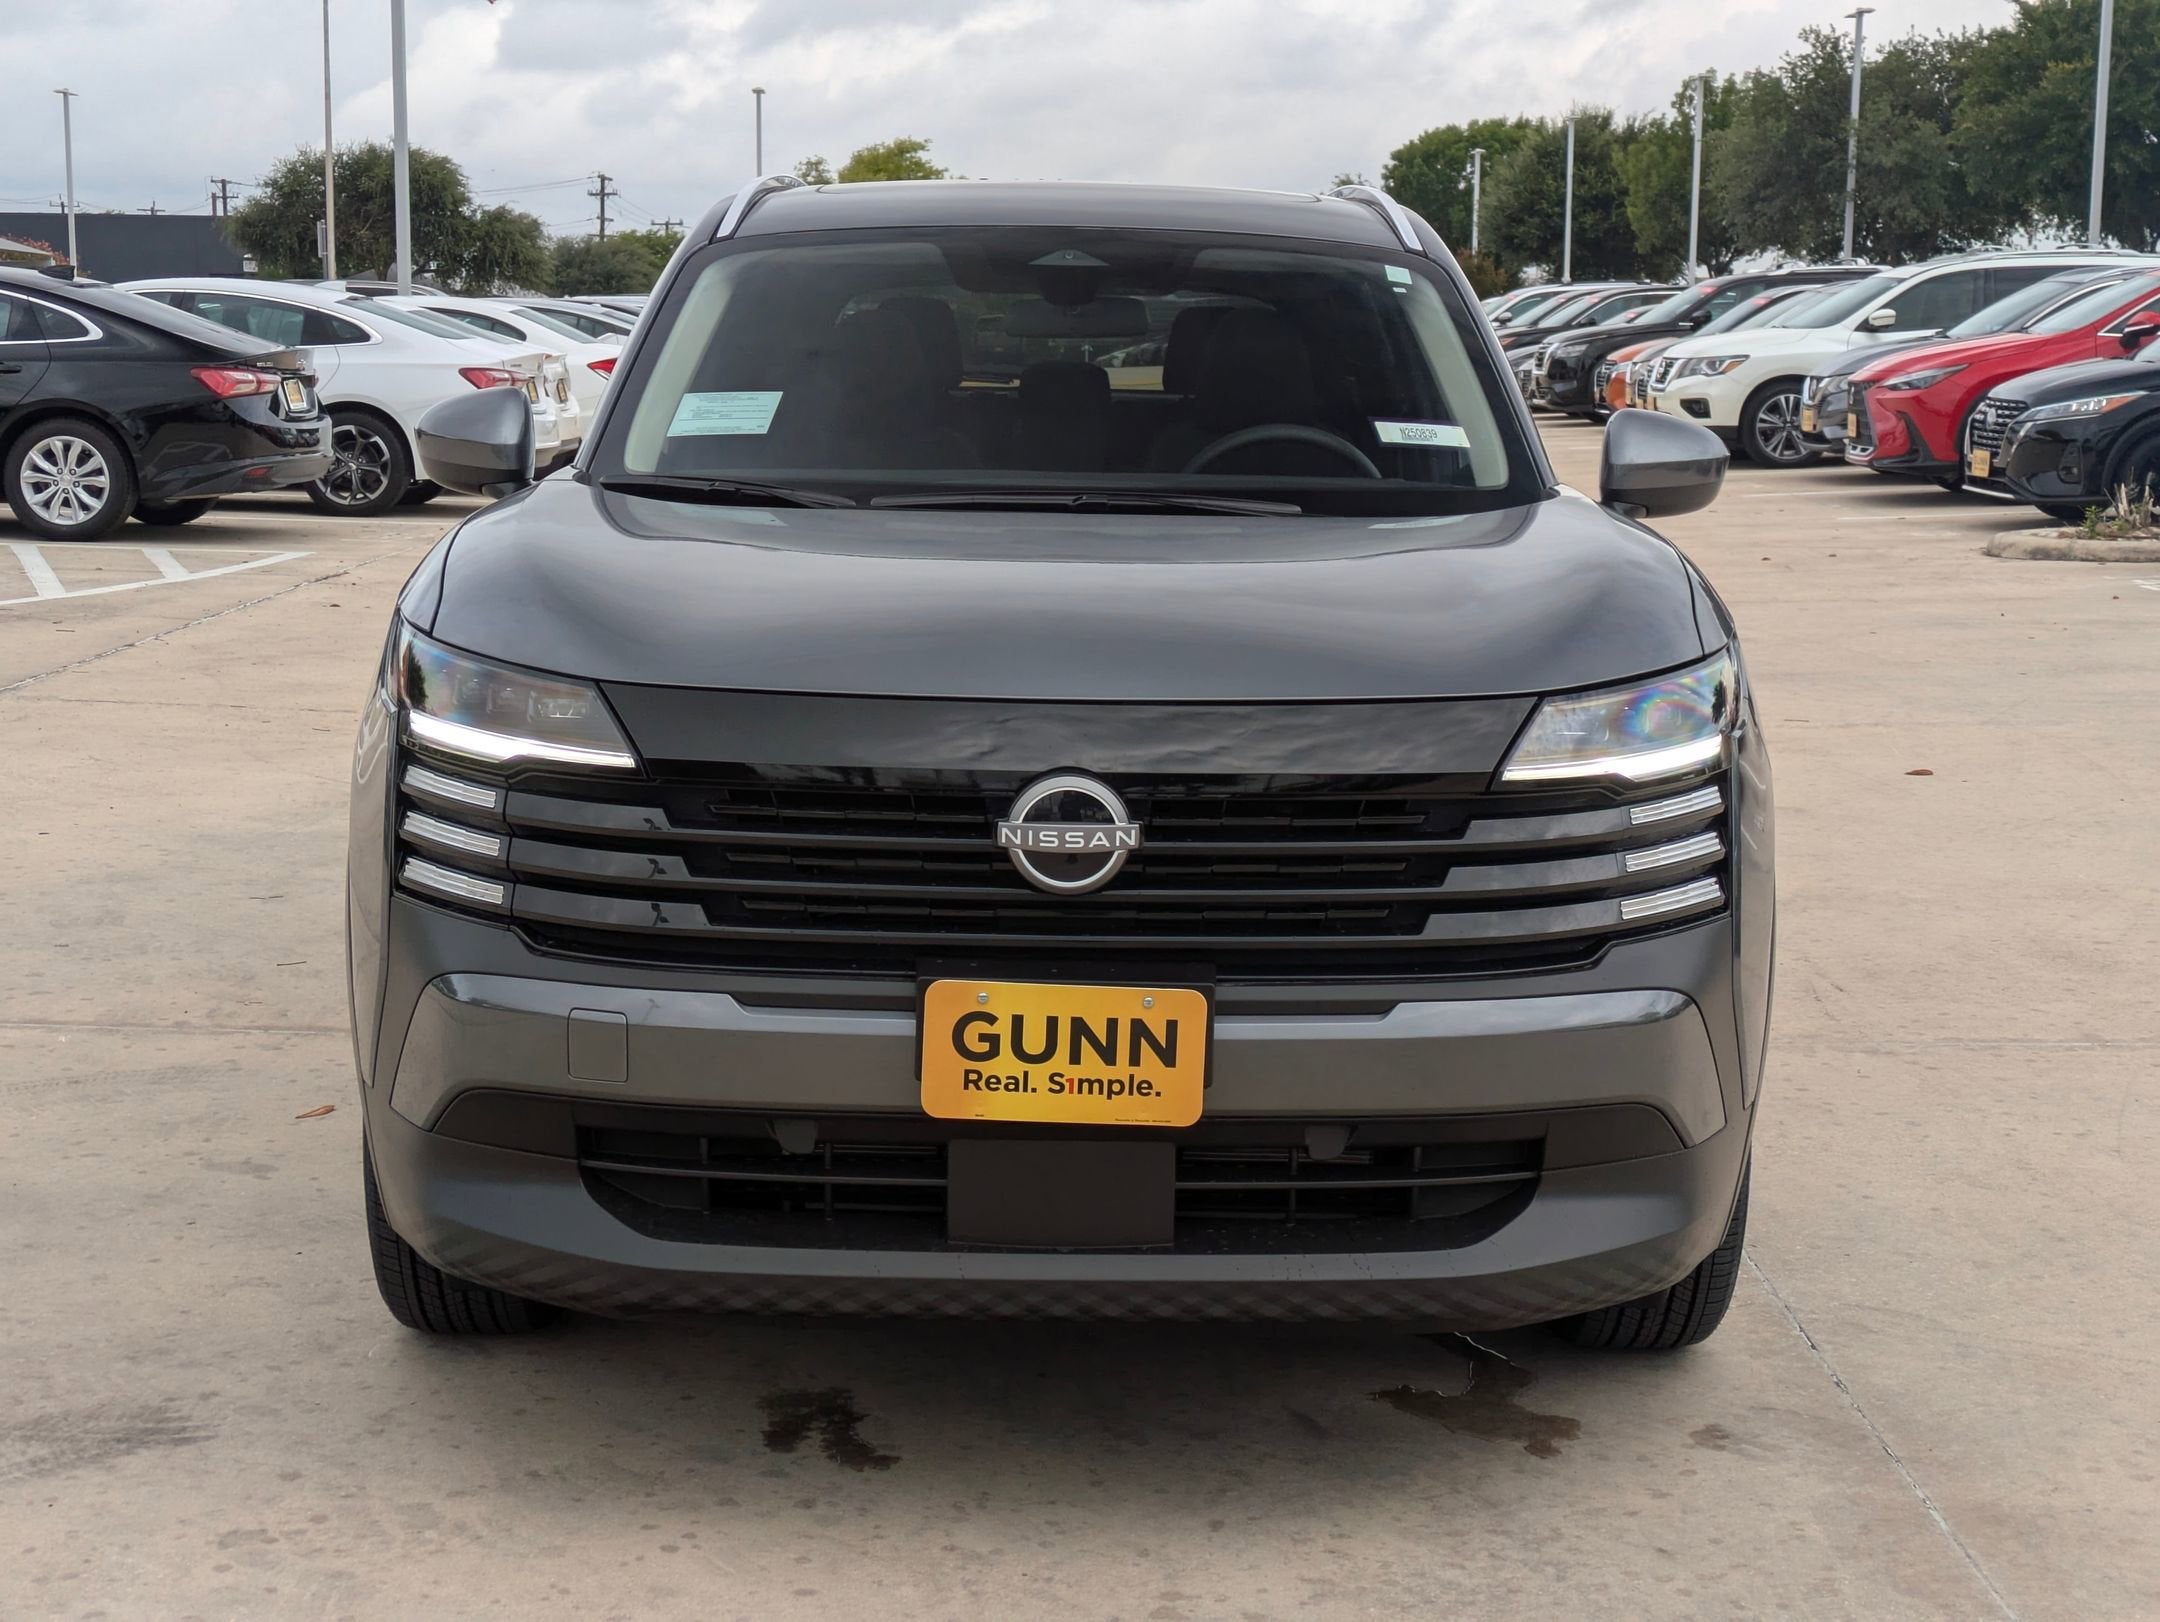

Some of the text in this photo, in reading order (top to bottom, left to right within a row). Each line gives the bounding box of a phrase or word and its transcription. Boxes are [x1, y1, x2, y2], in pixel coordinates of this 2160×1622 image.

[1001, 827, 1136, 848] NISSAN
[951, 1010, 1179, 1069] GUNN
[963, 1068, 1038, 1094] Real.
